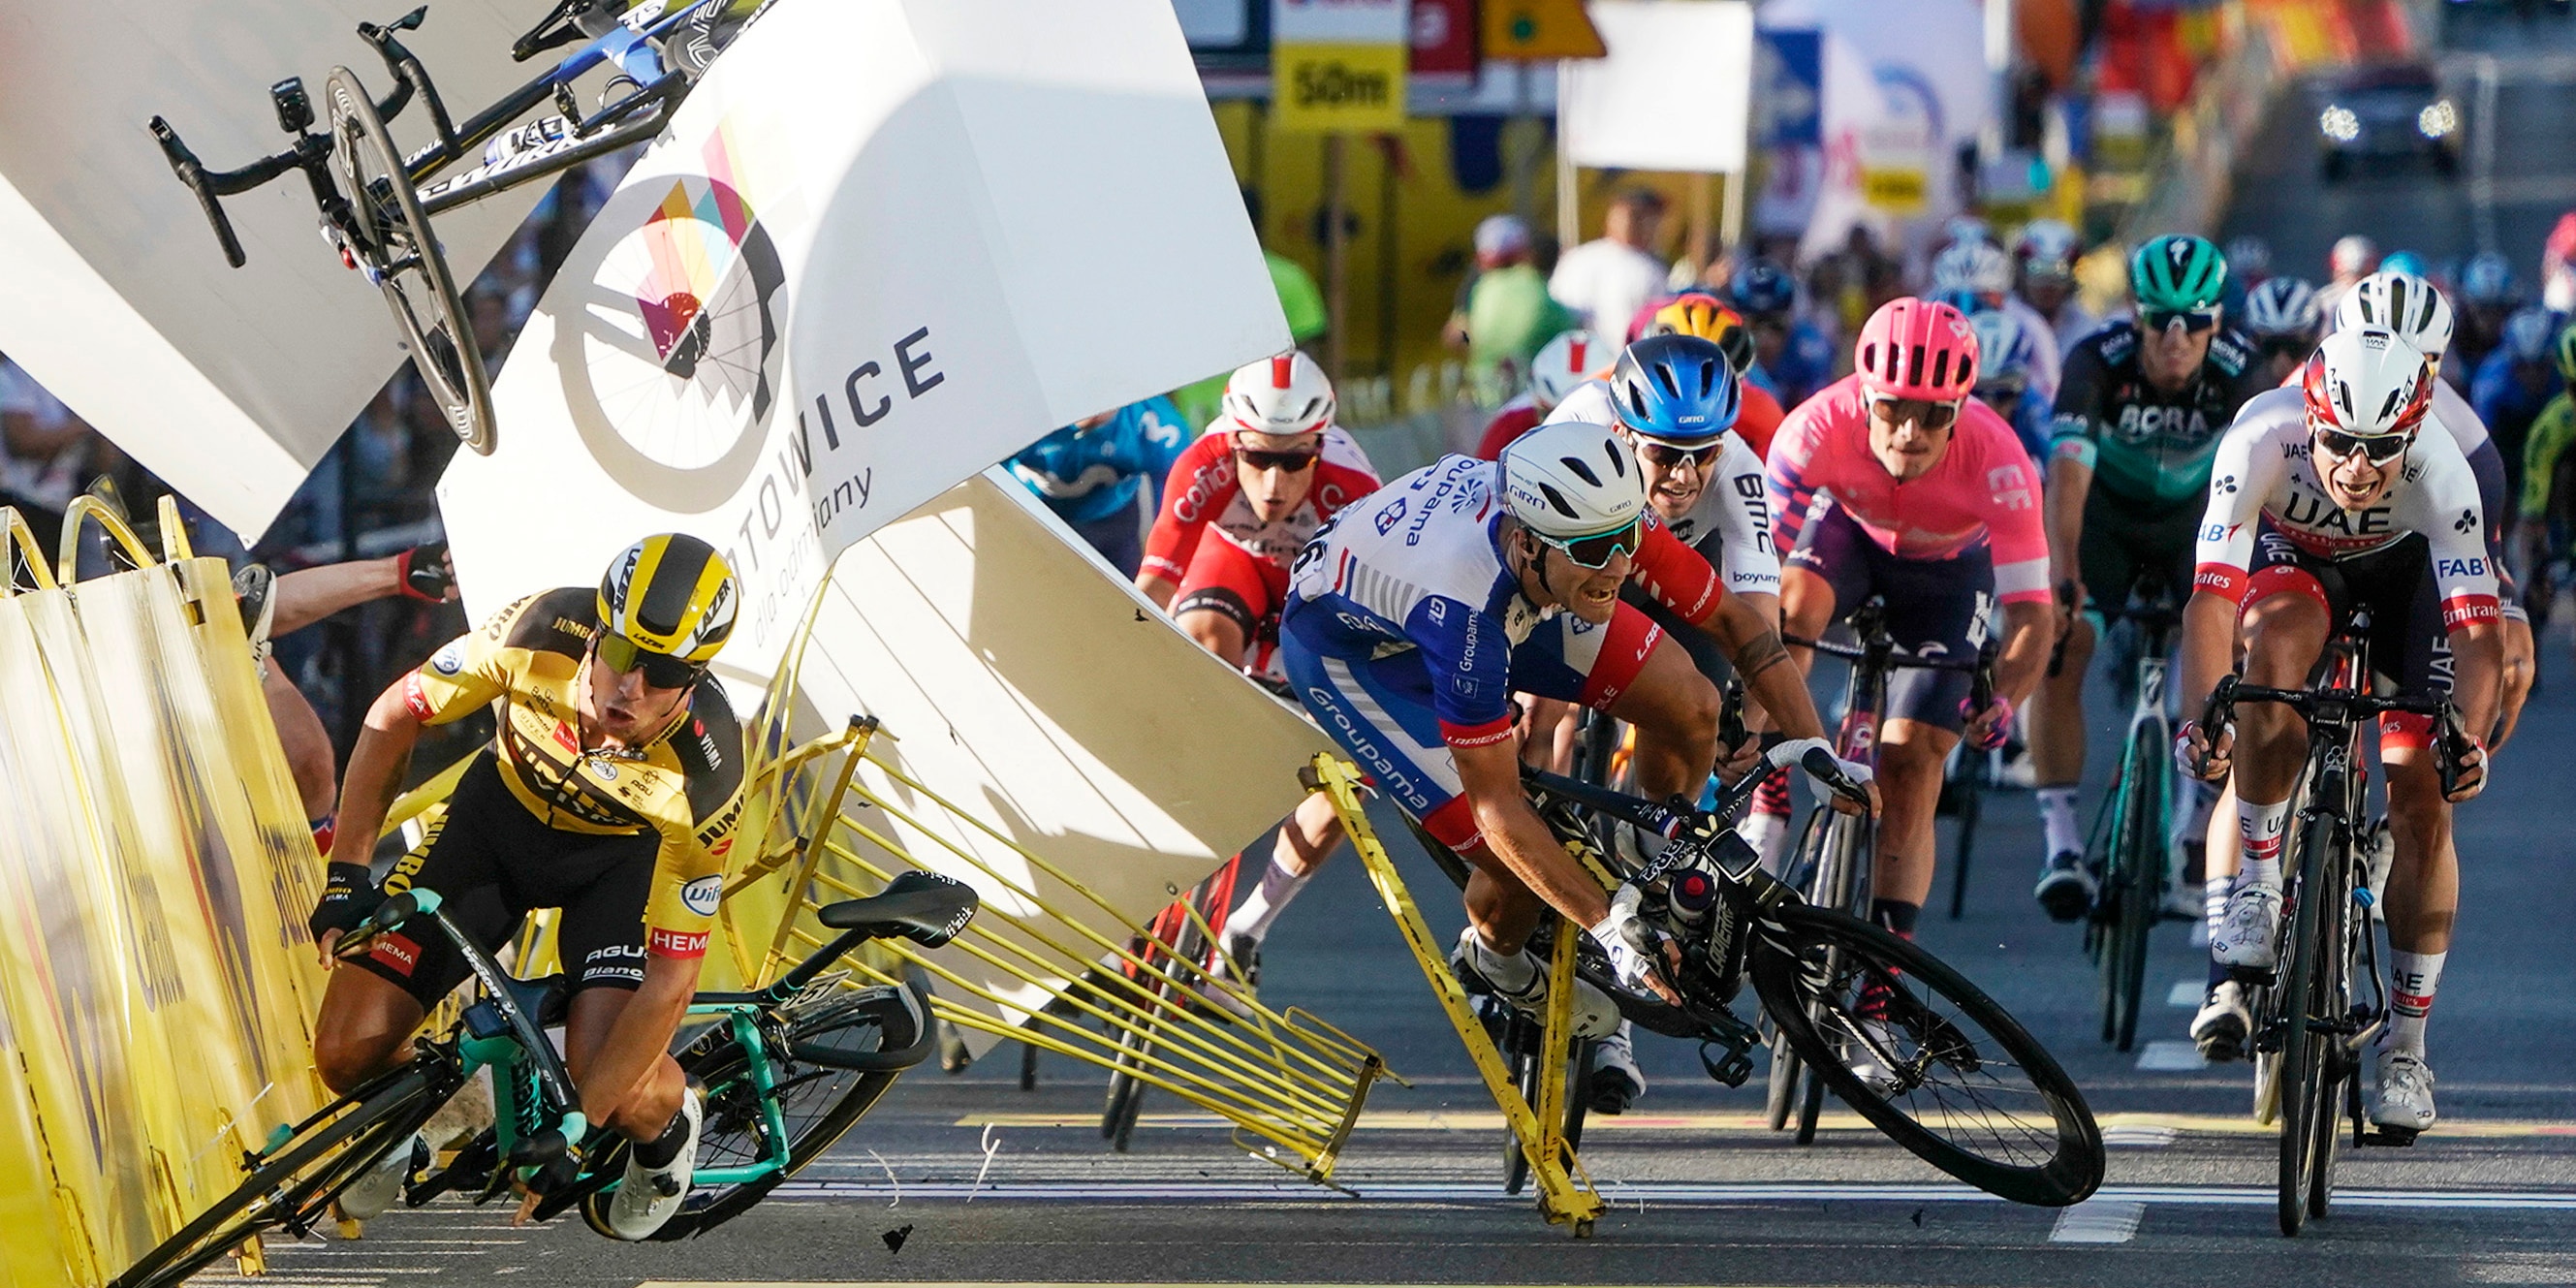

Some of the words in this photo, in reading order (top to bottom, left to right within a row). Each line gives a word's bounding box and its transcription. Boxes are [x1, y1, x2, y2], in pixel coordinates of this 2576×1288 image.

[1294, 60, 1390, 108] 50m
[1509, 485, 1545, 511] GIRO
[1609, 499, 1632, 514] GIRO
[2283, 491, 2391, 536] UAE
[1733, 473, 1776, 556] BMC
[2260, 532, 2299, 564] UAE
[613, 549, 642, 614] LAZER
[692, 578, 731, 644] LAZER
[2442, 603, 2499, 625] Emirate
[552, 616, 593, 640] JUMB
[633, 633, 665, 650] LAZER
[1460, 607, 1480, 672] Groupama
[700, 733, 722, 771] VISMA
[1308, 686, 1429, 810] Groupama
[1447, 727, 1513, 745] LAPIERR
[653, 931, 707, 952] HEM
[2391, 966, 2425, 991] AE
